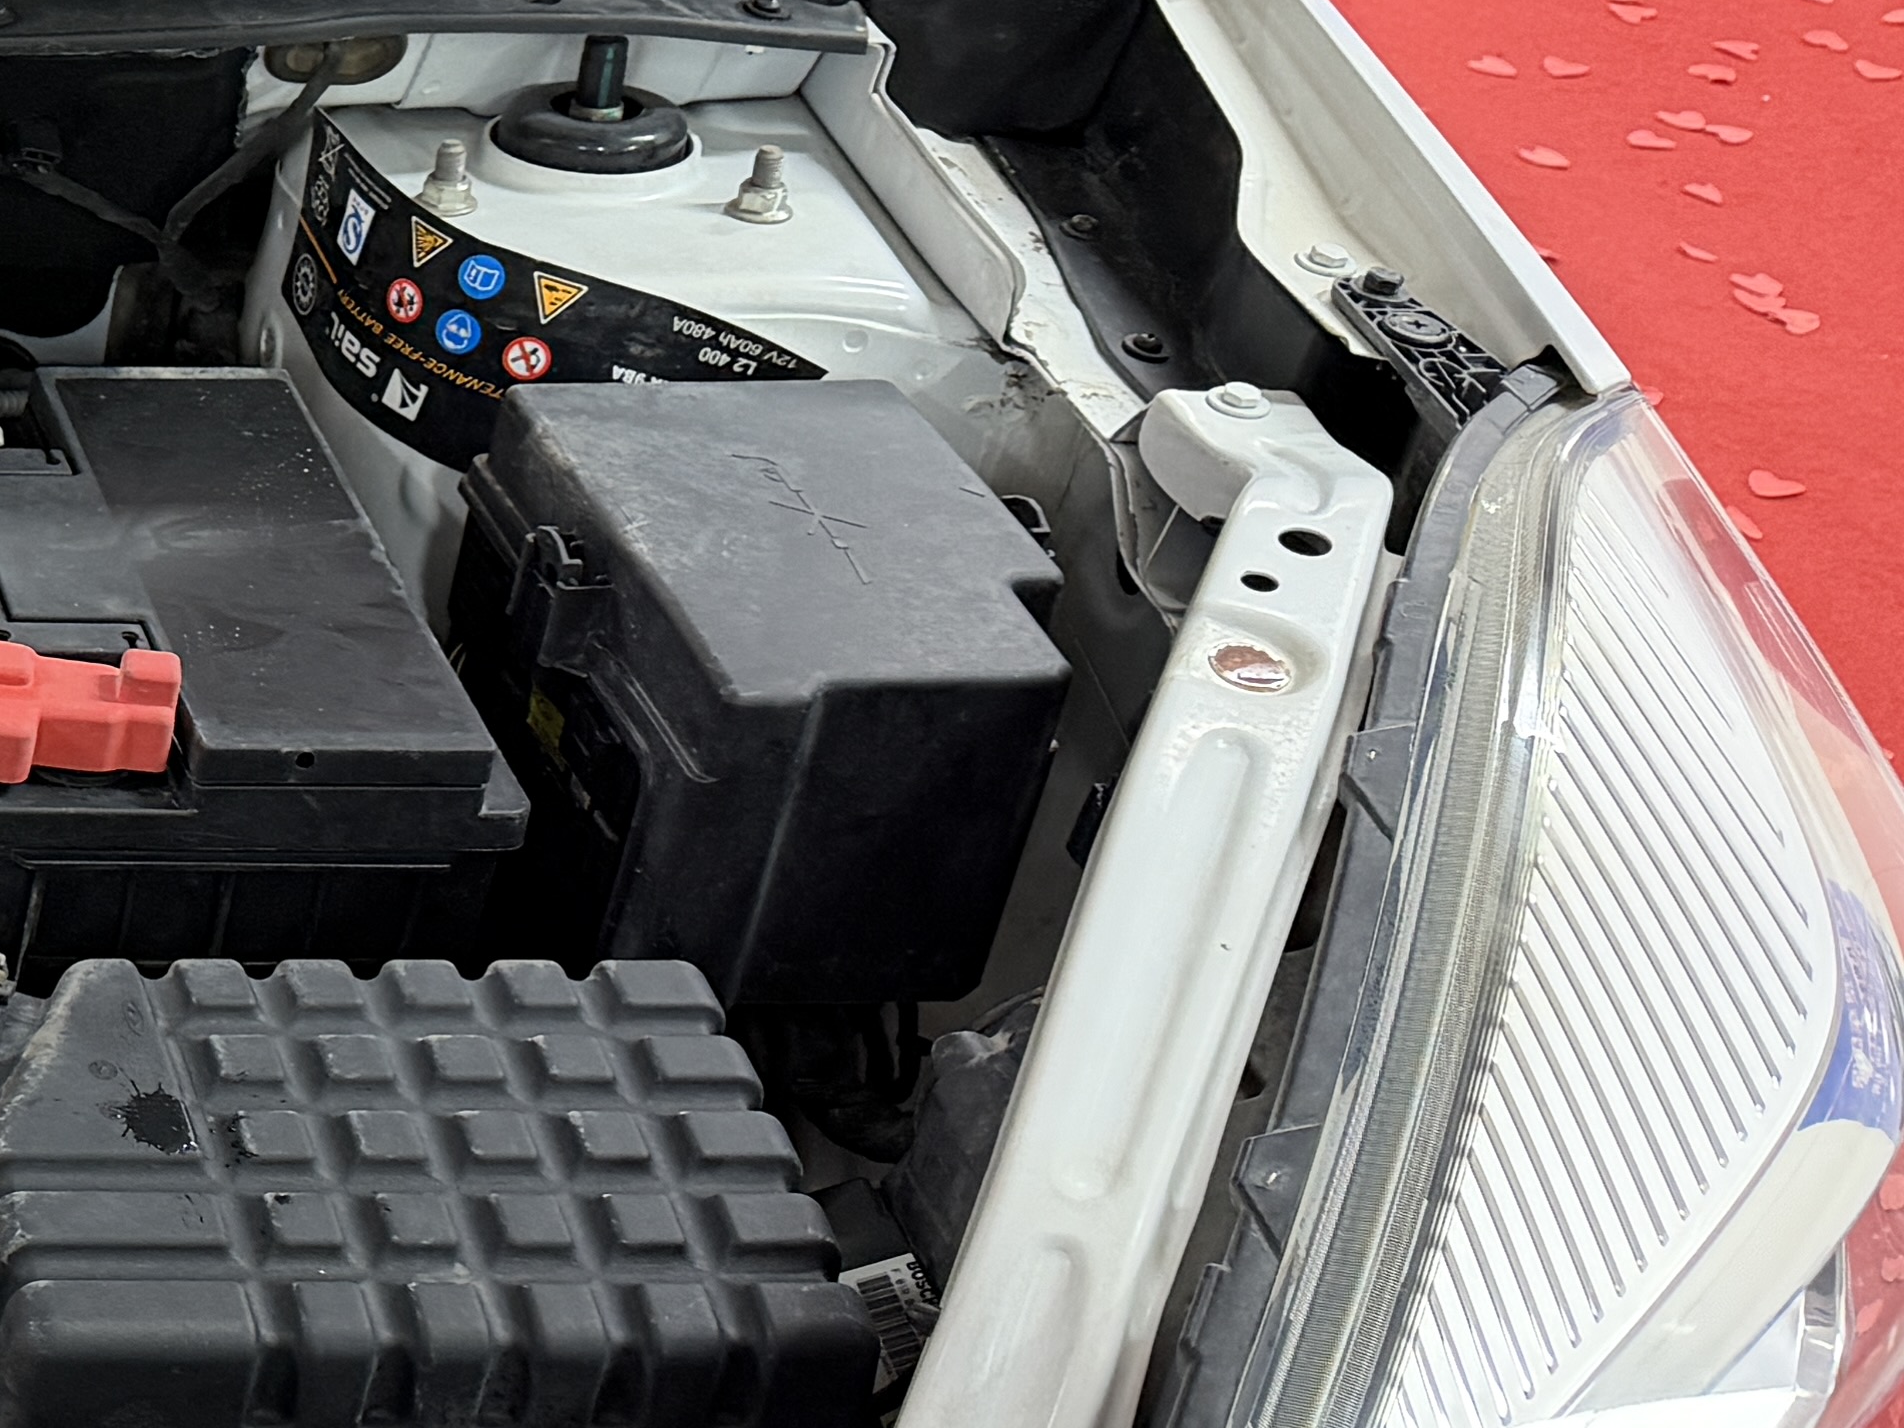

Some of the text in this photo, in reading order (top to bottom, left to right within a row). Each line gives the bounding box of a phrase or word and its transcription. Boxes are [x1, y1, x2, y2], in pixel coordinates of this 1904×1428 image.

[337, 289, 384, 335] BATTERY
[673, 316, 797, 369] 12V 60Ah 480A
[698, 347, 758, 376] L2 400
